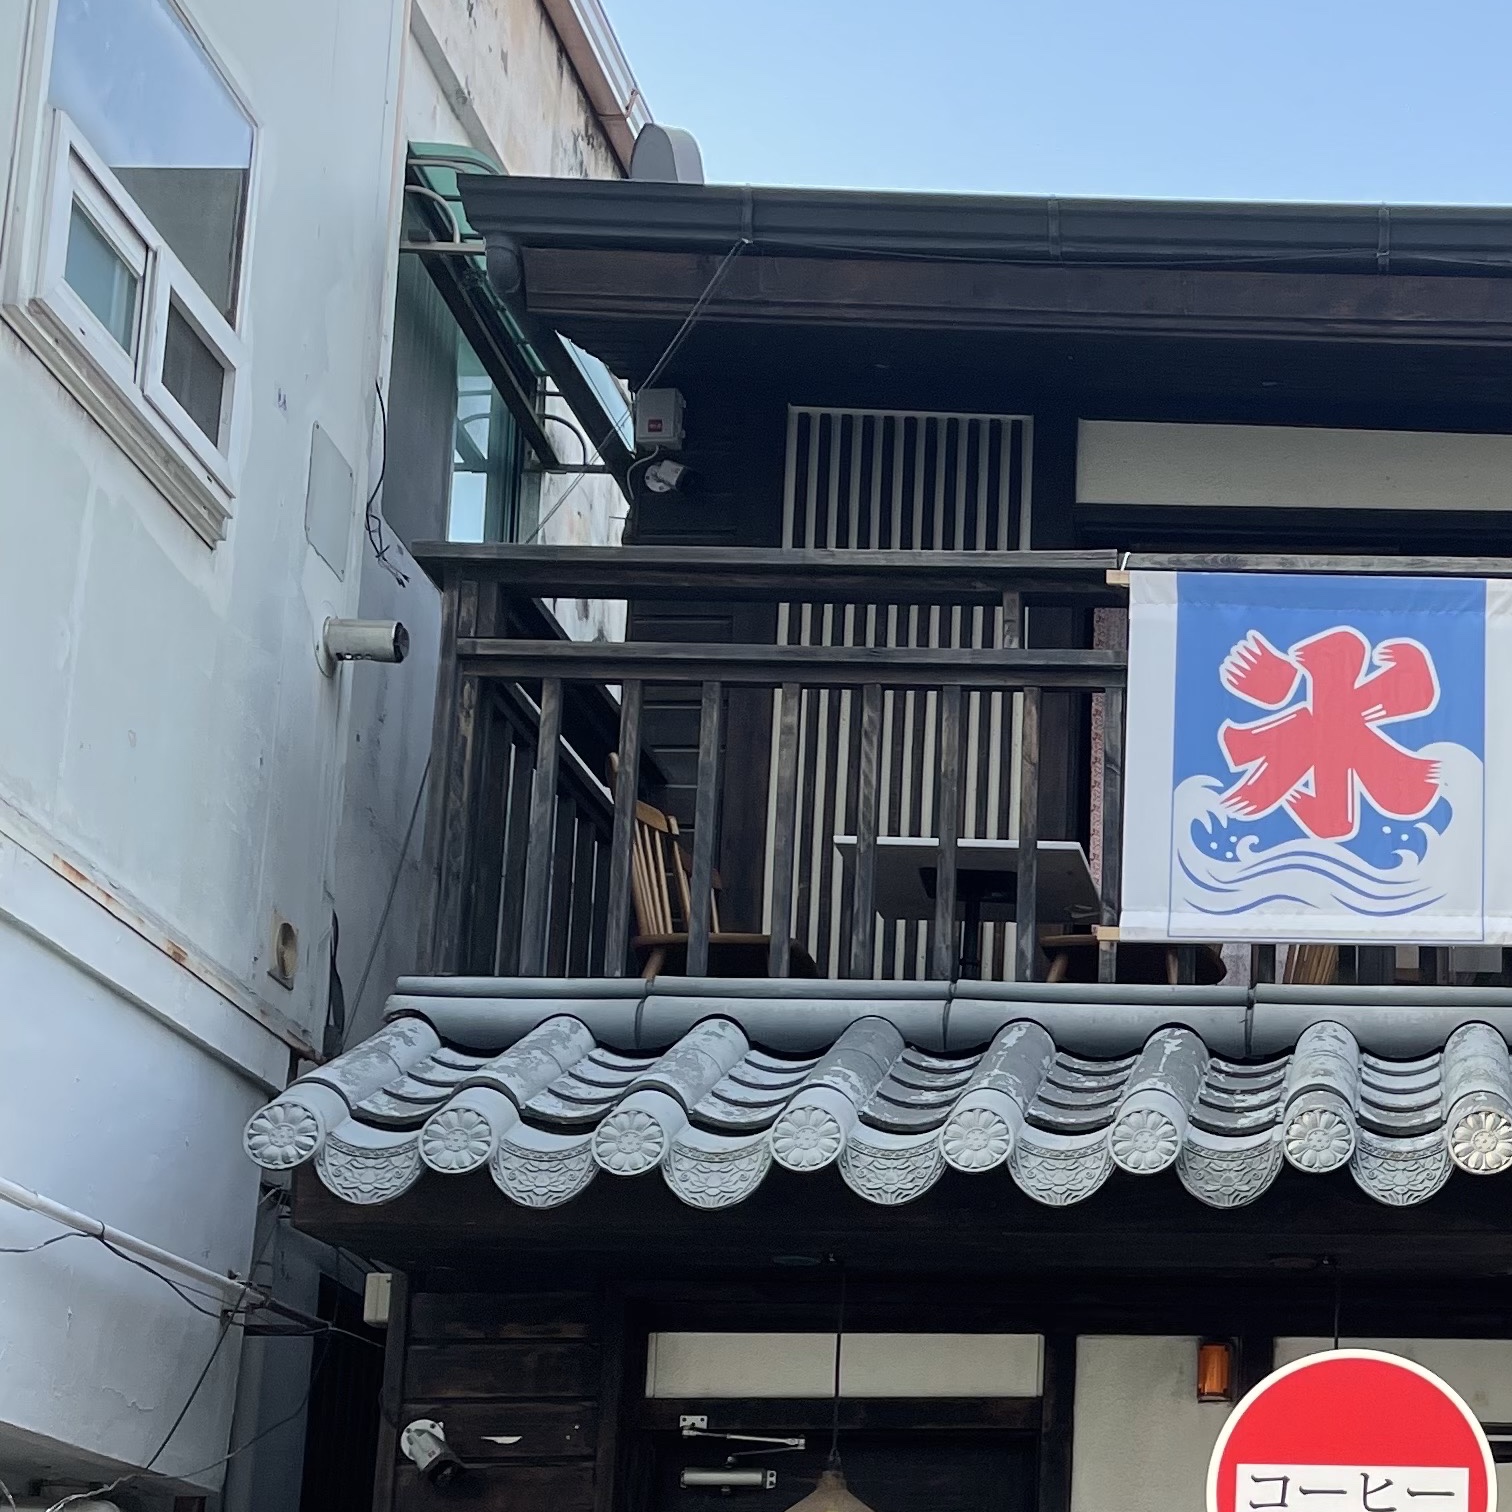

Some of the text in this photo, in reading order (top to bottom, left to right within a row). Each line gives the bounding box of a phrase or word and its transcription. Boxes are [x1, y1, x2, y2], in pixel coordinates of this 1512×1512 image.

[1218, 625, 1441, 843] 氷
[1249, 1472, 1455, 1512] コーヒー
